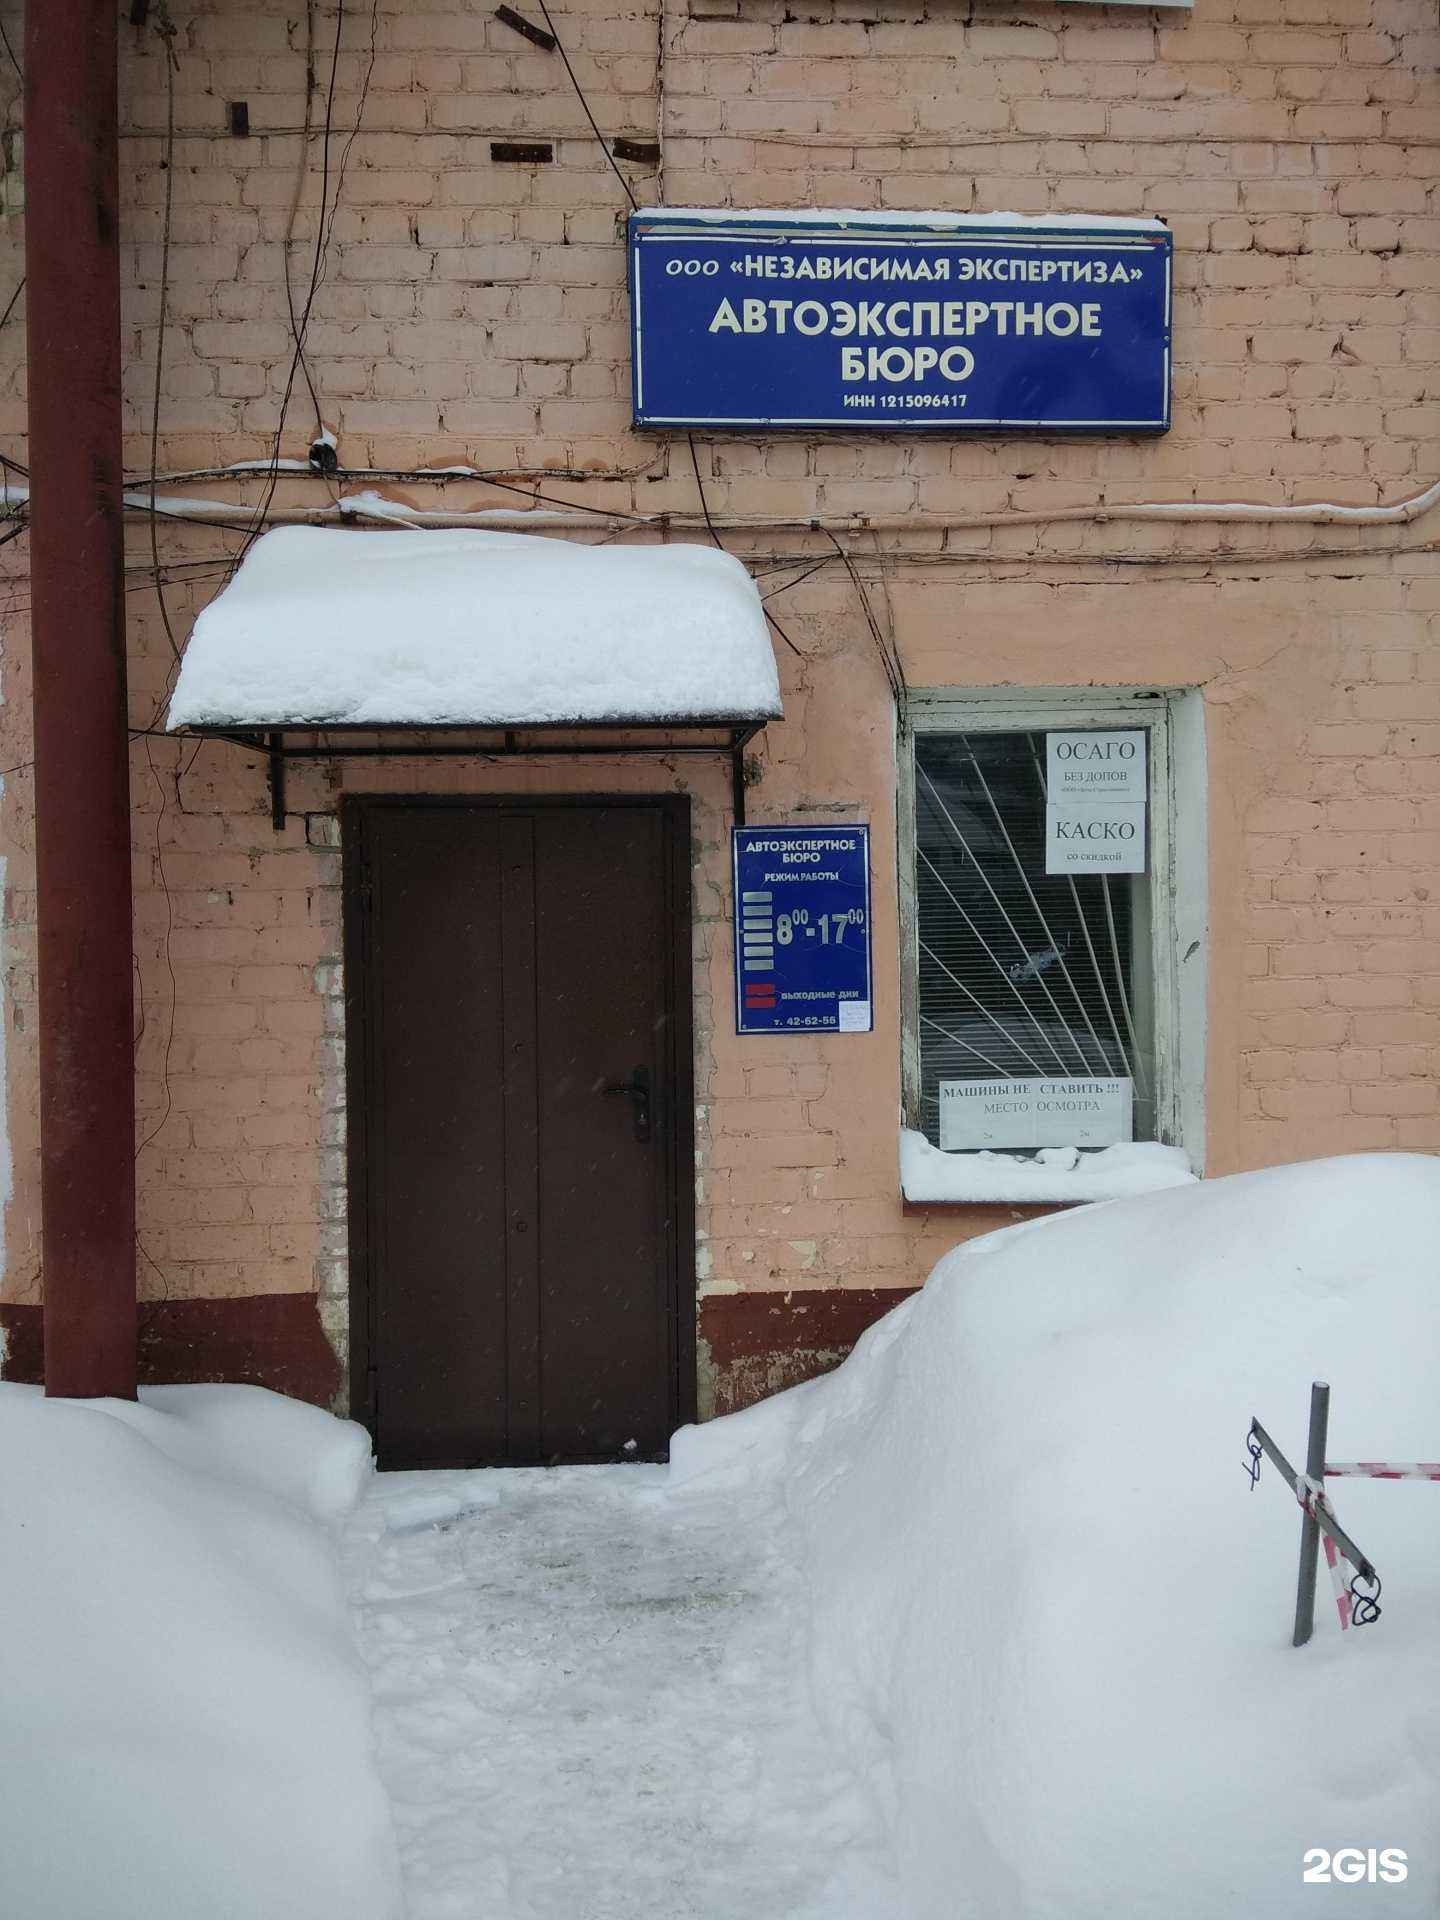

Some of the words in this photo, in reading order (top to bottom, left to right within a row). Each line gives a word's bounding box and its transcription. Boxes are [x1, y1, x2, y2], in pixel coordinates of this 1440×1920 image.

[666, 259, 719, 276] ООО
[730, 255, 950, 281] «НЕЗАВИСИМАЯ
[959, 258, 1142, 284] ЭКСПЕРТИЗА»
[708, 297, 1103, 337] АВТОЭКСПЕРТНОЕ
[841, 346, 975, 383] БЮРО
[843, 395, 876, 408] ИНН
[880, 394, 967, 408] 1215096417
[1056, 742, 1136, 760] ОСАГО
[1085, 771, 1128, 783] ДОПОВ
[1056, 821, 1136, 840] КАСКО
[746, 839, 856, 852] АВТОЭКСПЕРТНОЕ
[782, 852, 821, 864] БЮРО
[764, 872, 800, 882] РЕЖИМ
[800, 871, 839, 882] РАБОТЫ
[943, 1085, 1010, 1099] МАШИНЫ
[1013, 1083, 1032, 1095] НЕ
[984, 1102, 1029, 1114] МЕСТО
[1036, 1100, 1101, 1112] ОСМОТРА
